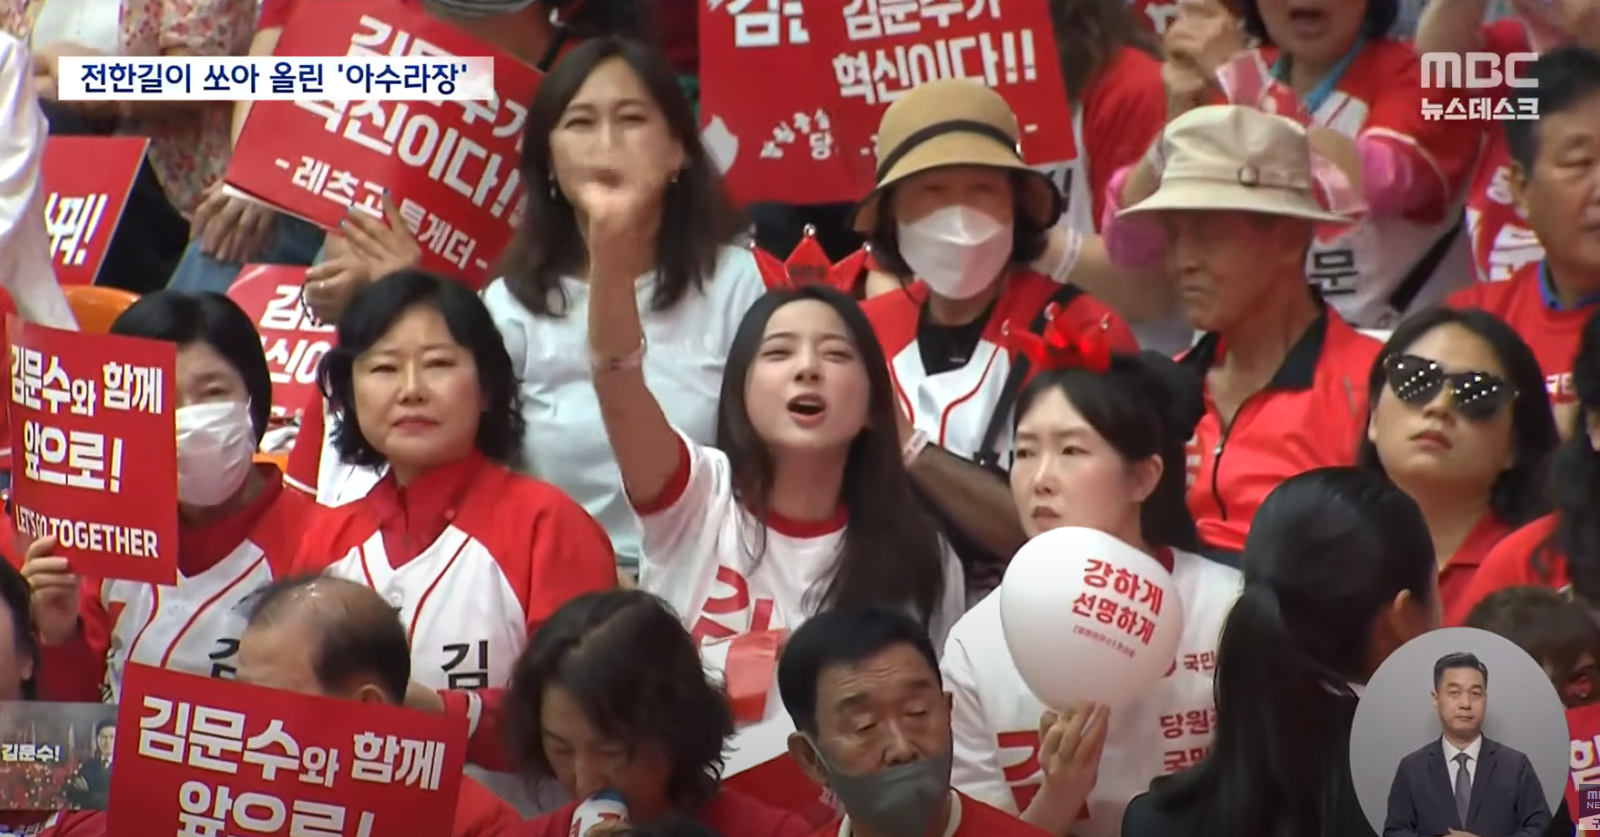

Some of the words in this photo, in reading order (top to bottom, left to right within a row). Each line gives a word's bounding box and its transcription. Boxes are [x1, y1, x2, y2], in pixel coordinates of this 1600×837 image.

[291, 155, 389, 219] 레츠고
[11, 344, 97, 417] 김문수와
[102, 361, 163, 415] 함께
[23, 420, 124, 493] 앞으로!
[48, 517, 160, 559] TOGETHER
[1072, 591, 1156, 646] 선명하게
[1083, 558, 1165, 617] 강하게
[138, 695, 341, 788] 김문수와
[350, 731, 446, 791] 함께
